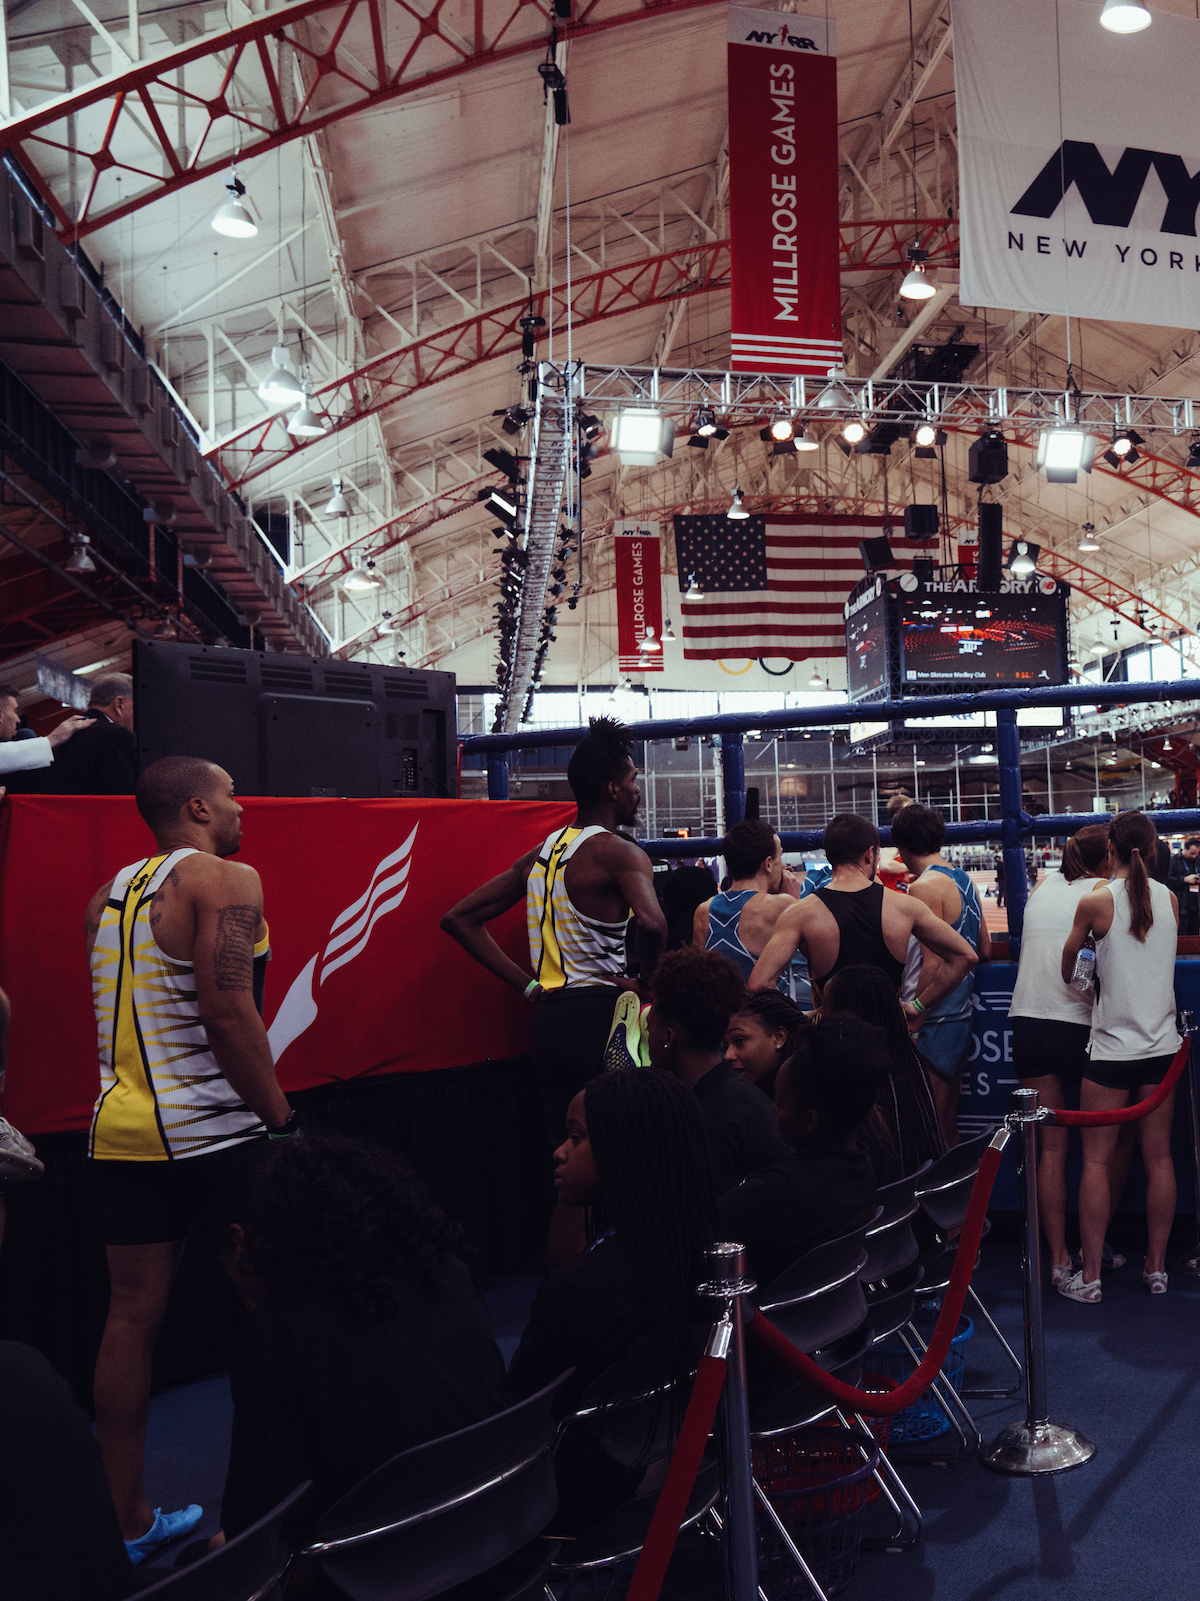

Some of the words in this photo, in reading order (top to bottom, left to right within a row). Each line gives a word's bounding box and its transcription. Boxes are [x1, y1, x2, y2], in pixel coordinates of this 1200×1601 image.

[769, 63, 796, 166] GAMES
[771, 174, 799, 322] MILLROSE
[1007, 230, 1087, 258] NEW
[631, 542, 644, 586] GAMES
[924, 581, 951, 593] THE
[952, 579, 1033, 594] ARORY
[632, 589, 646, 654] MILLROSE
